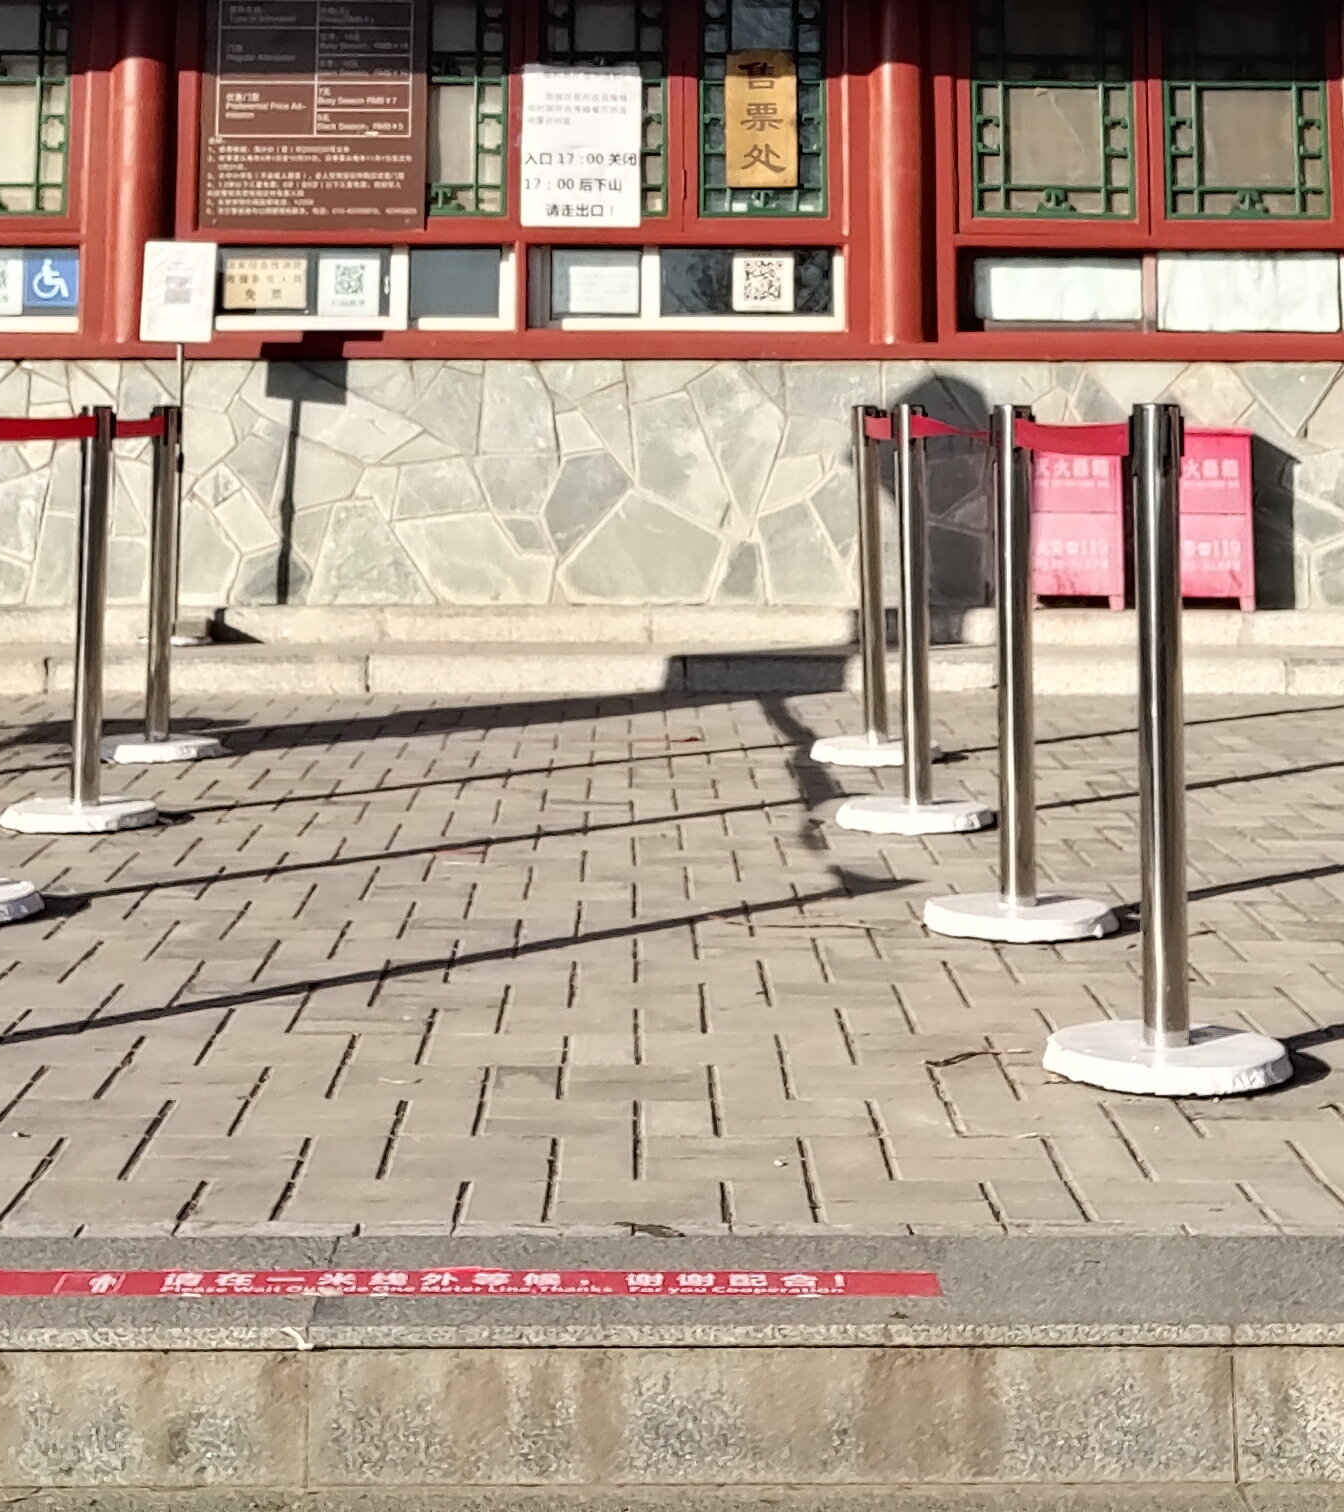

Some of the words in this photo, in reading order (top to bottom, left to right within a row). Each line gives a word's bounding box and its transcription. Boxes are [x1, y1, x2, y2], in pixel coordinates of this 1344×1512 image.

[738, 61, 786, 174] 售票处
[233, 1285, 280, 1293] Wait
[285, 1285, 369, 1293] Oude
[420, 1285, 482, 1293] Meter
[628, 1285, 662, 1293] For
